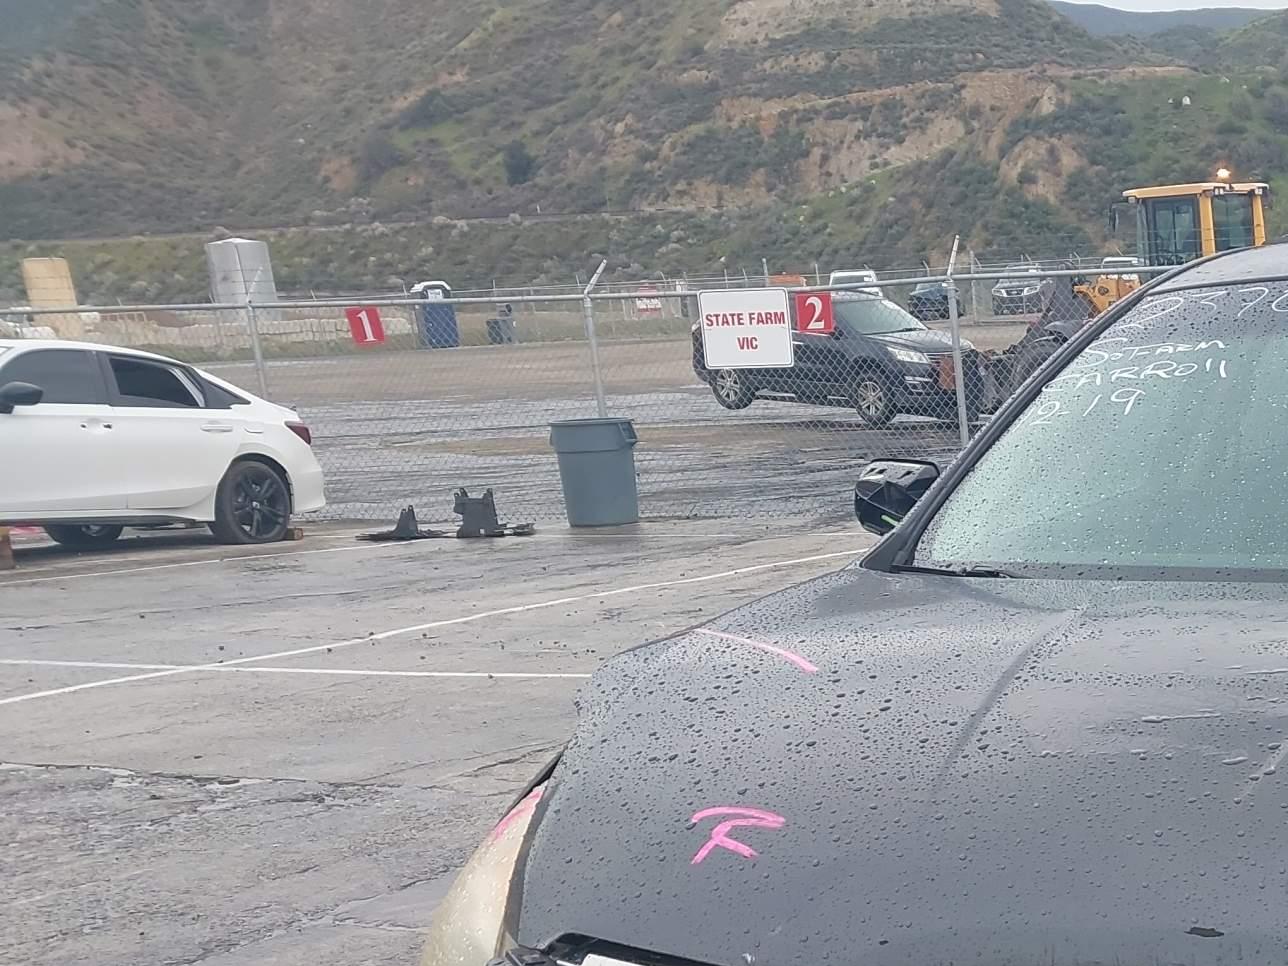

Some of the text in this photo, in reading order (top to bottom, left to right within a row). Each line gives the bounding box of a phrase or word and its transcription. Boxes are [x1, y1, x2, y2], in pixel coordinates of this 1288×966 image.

[705, 311, 786, 327] STATE FARM
[804, 296, 825, 329] 2
[356, 310, 377, 342] 1
[737, 336, 758, 350] VIC
